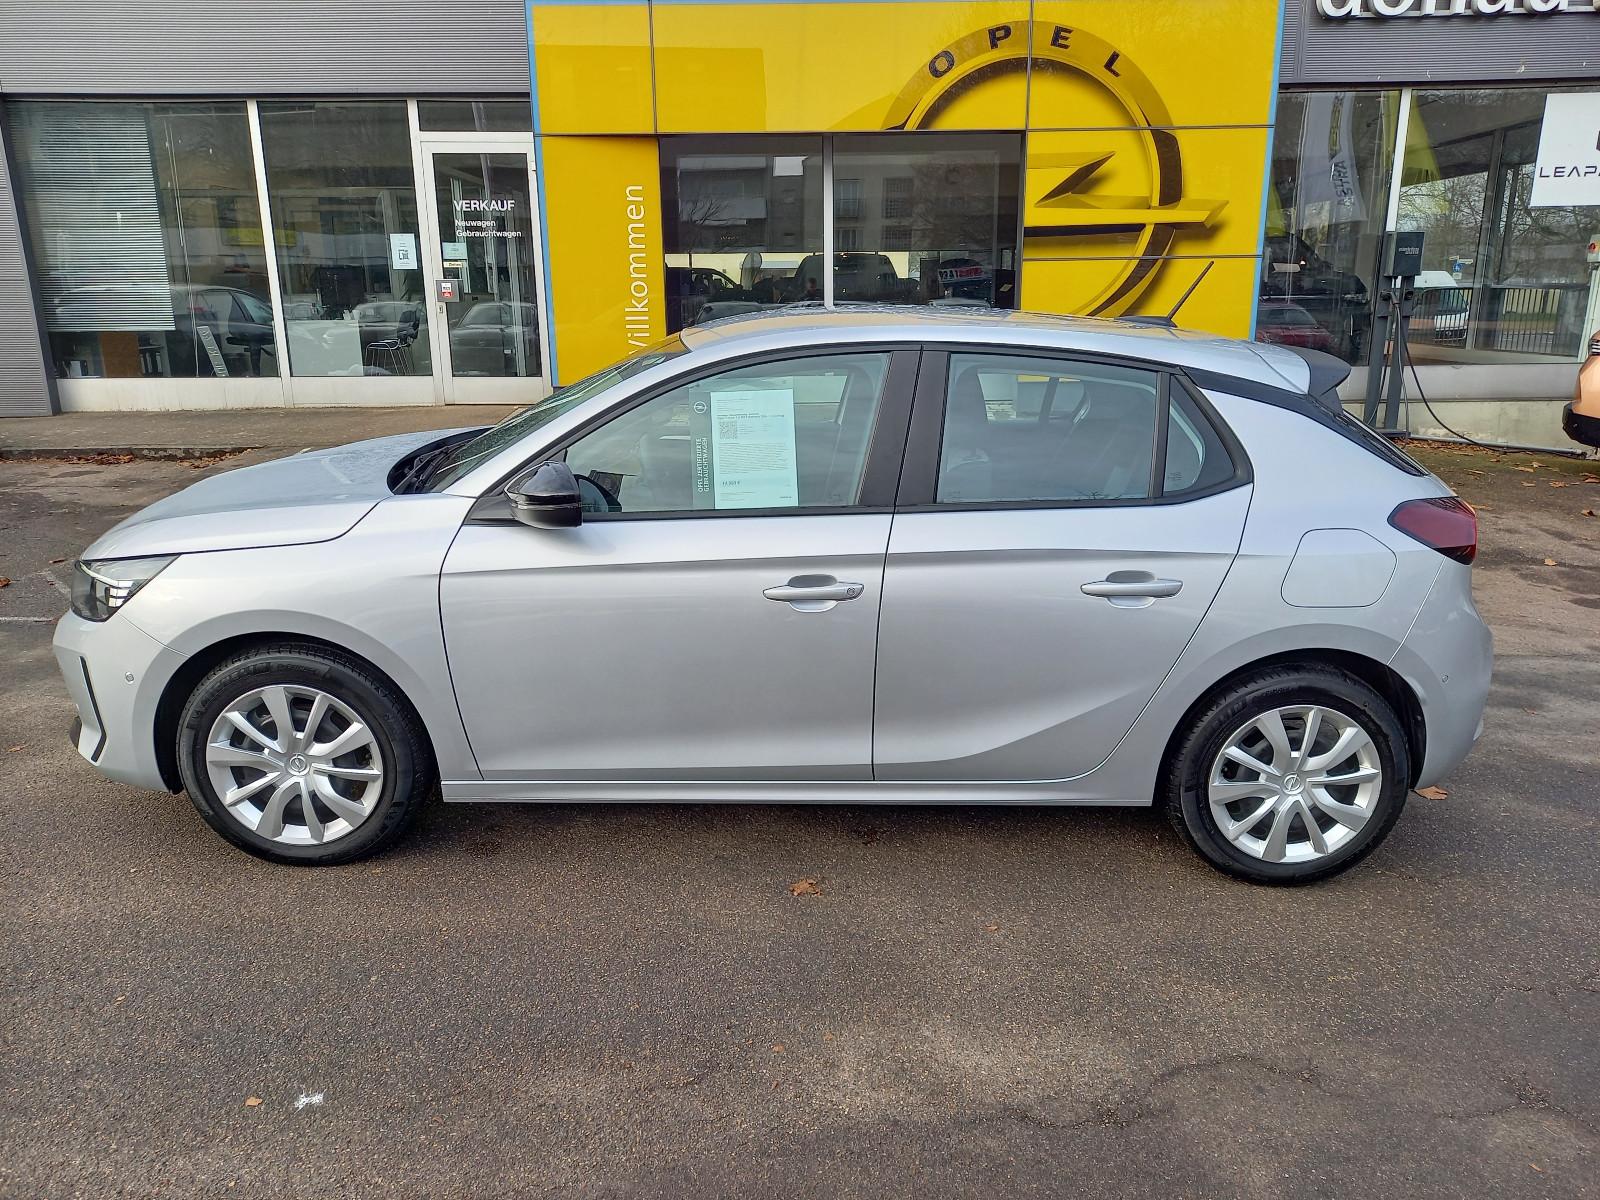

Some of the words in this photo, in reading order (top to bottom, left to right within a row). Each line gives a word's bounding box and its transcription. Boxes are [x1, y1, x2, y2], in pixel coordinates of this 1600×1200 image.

[928, 25, 1121, 78] OPEL
[1539, 166, 1600, 178] LEAP
[453, 199, 515, 212] VERKAUF
[455, 219, 496, 228] Neuwagen
[456, 230, 522, 239] Gebrauchtwagen
